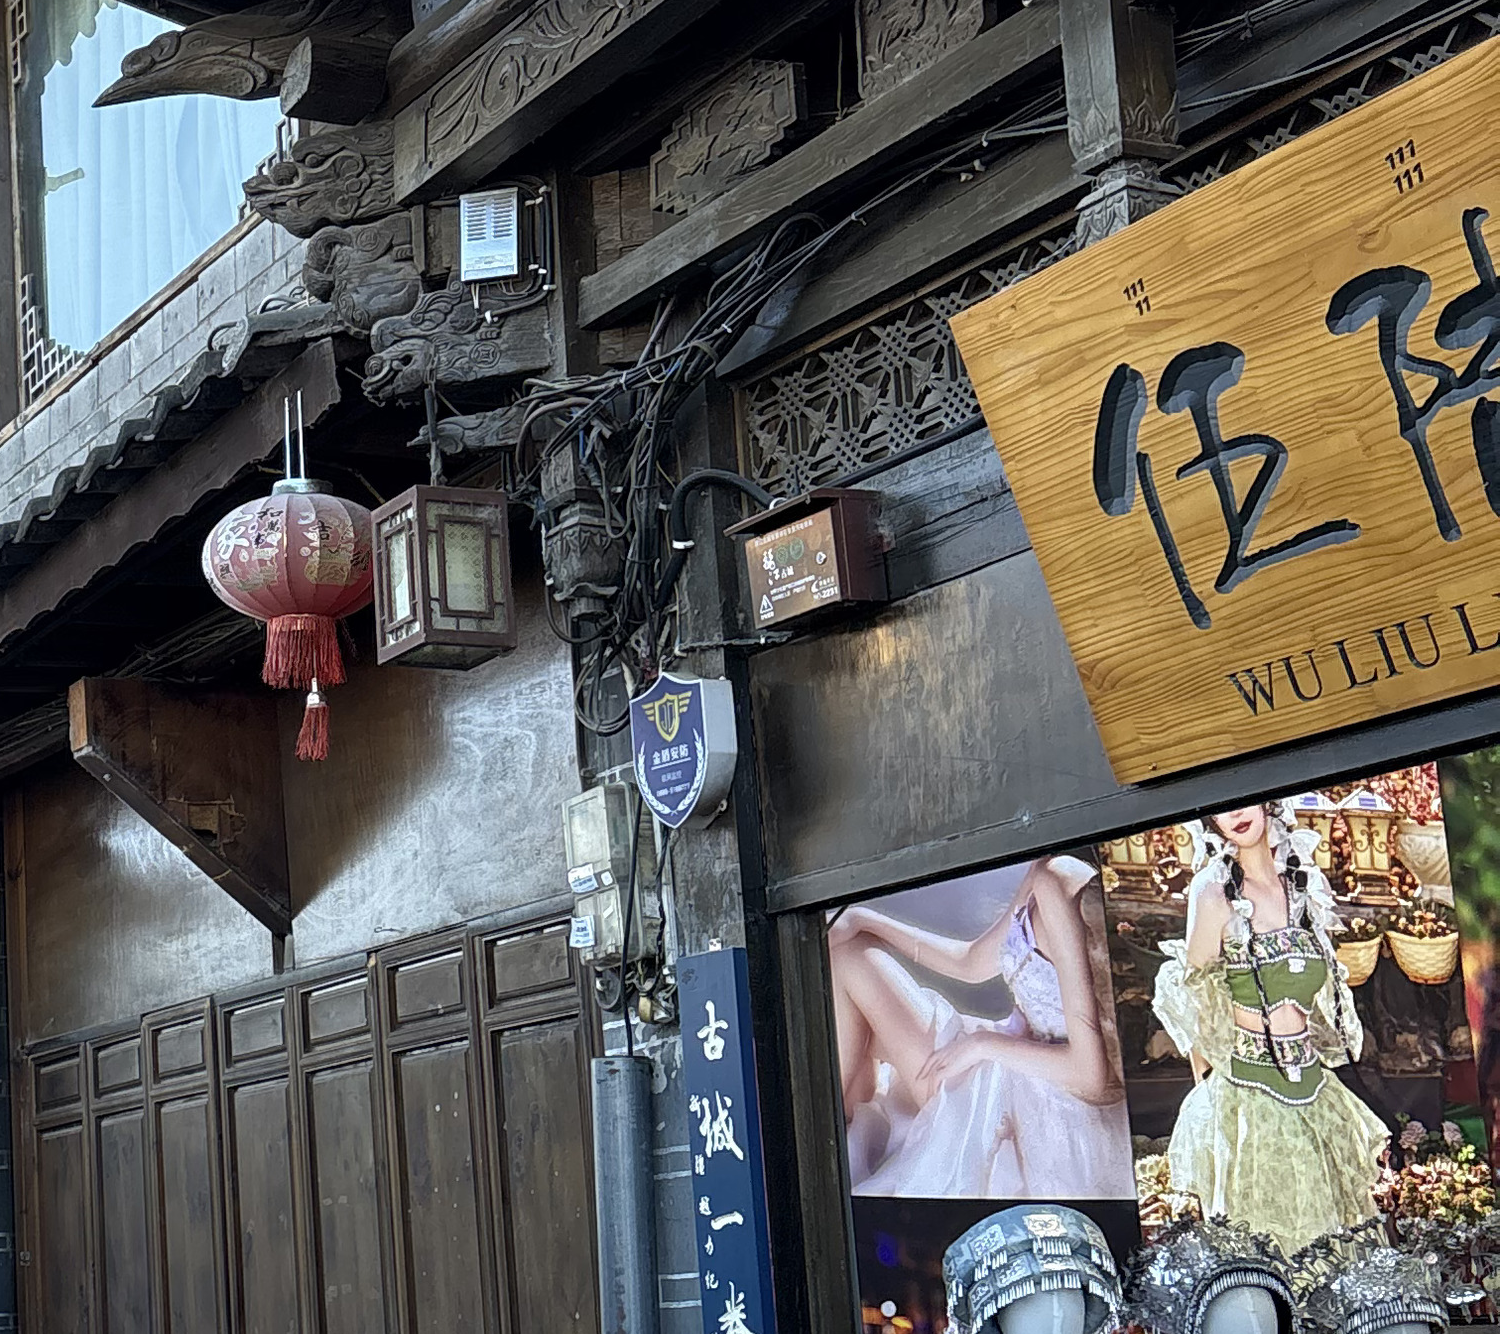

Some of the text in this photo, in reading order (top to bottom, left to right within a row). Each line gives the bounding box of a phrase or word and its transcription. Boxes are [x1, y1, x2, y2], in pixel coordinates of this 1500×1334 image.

[1226, 592, 1500, 716] WU LIU L
